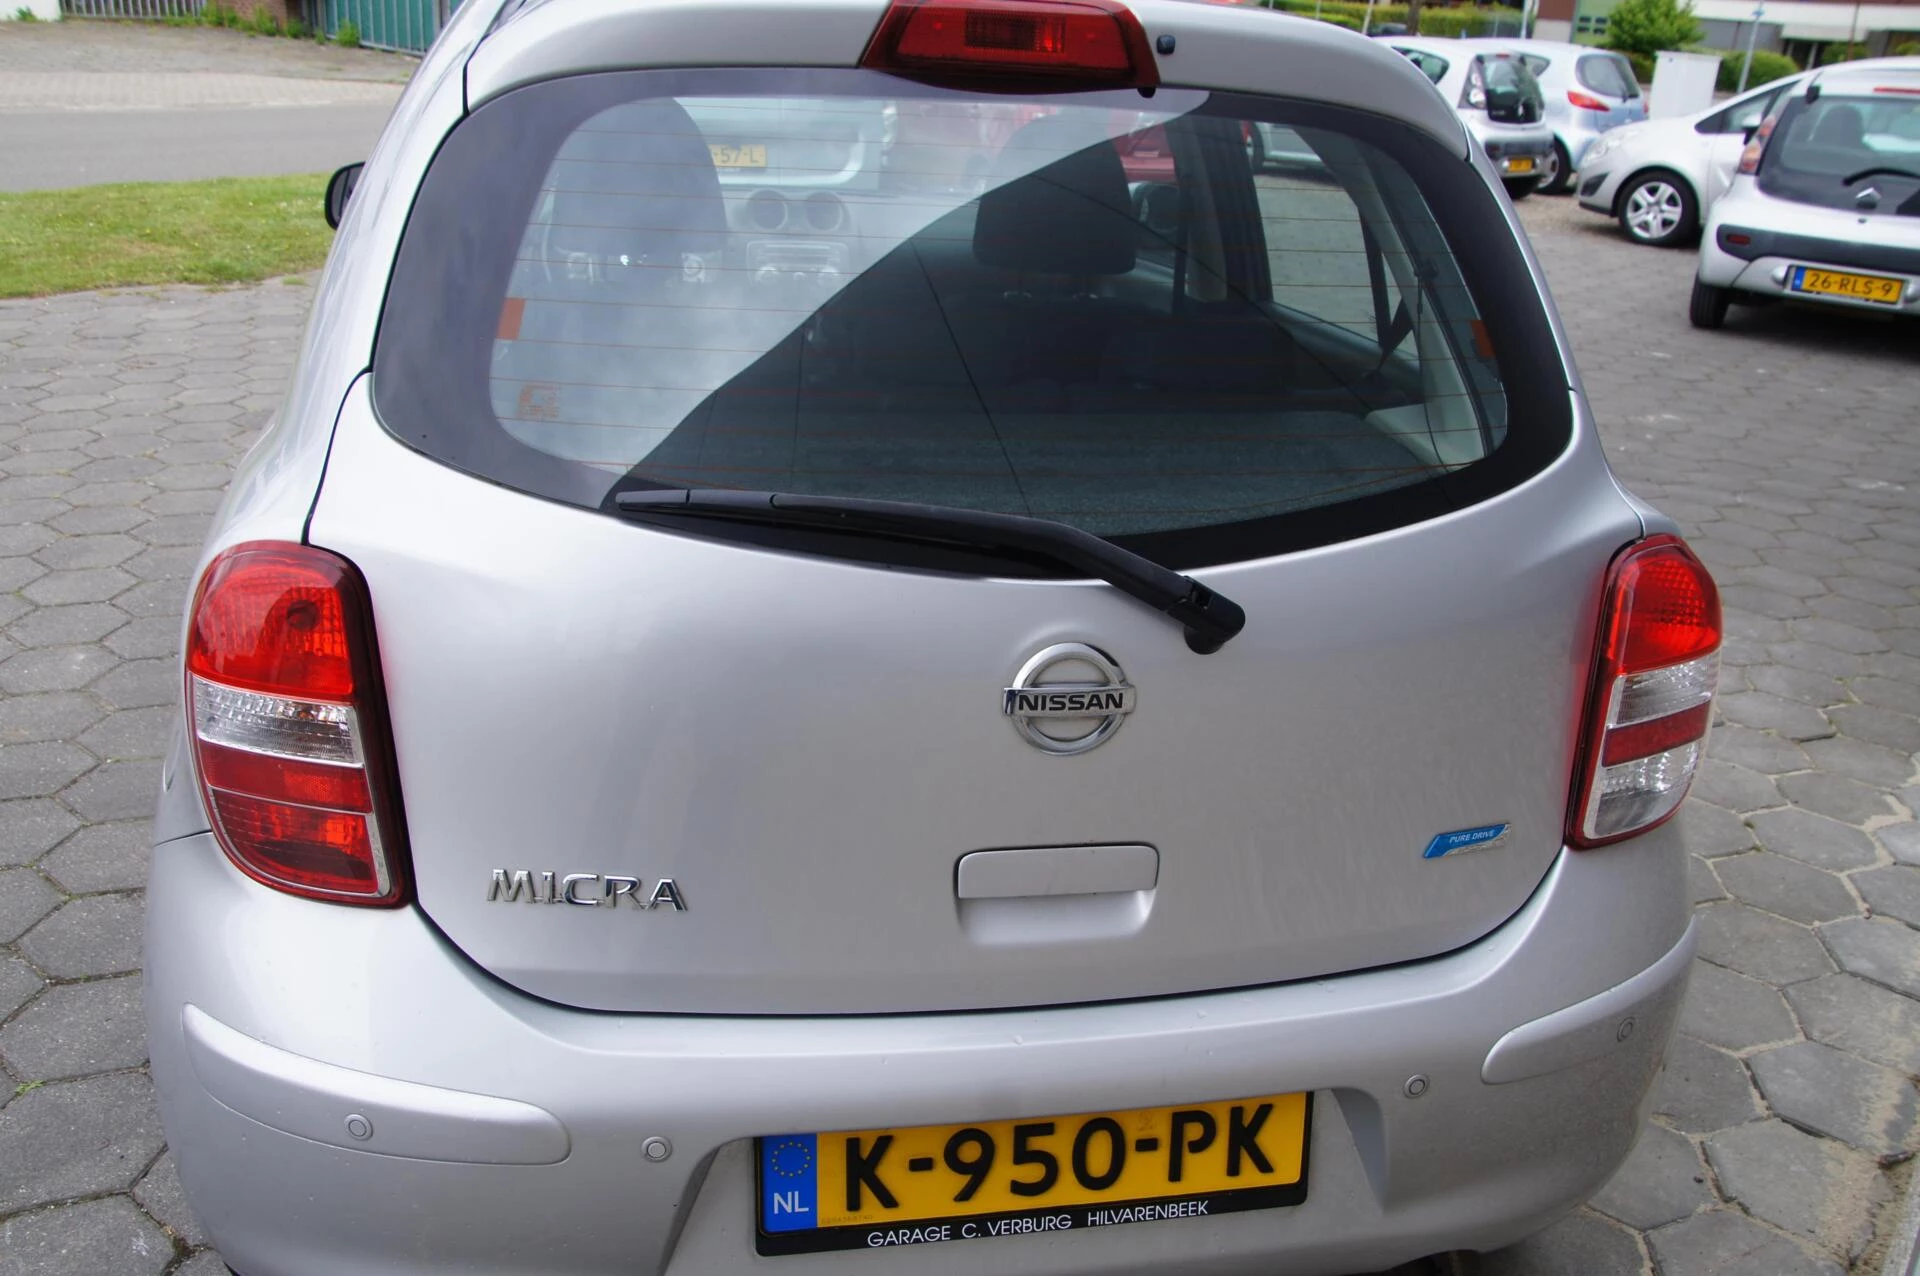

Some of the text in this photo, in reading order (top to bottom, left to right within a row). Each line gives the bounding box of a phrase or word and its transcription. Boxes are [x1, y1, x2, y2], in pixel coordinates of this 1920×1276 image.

[1809, 271, 1894, 297] 26-RLS-9
[1018, 693, 1123, 711] NISSAN
[1449, 829, 1496, 844] PURE DRIVE
[487, 868, 689, 912] MICRA
[846, 1103, 1275, 1212] K-950-PK
[773, 1190, 809, 1214] NL
[867, 1200, 1209, 1247] GARAGE C. VERBURG HILVARENBEEK
